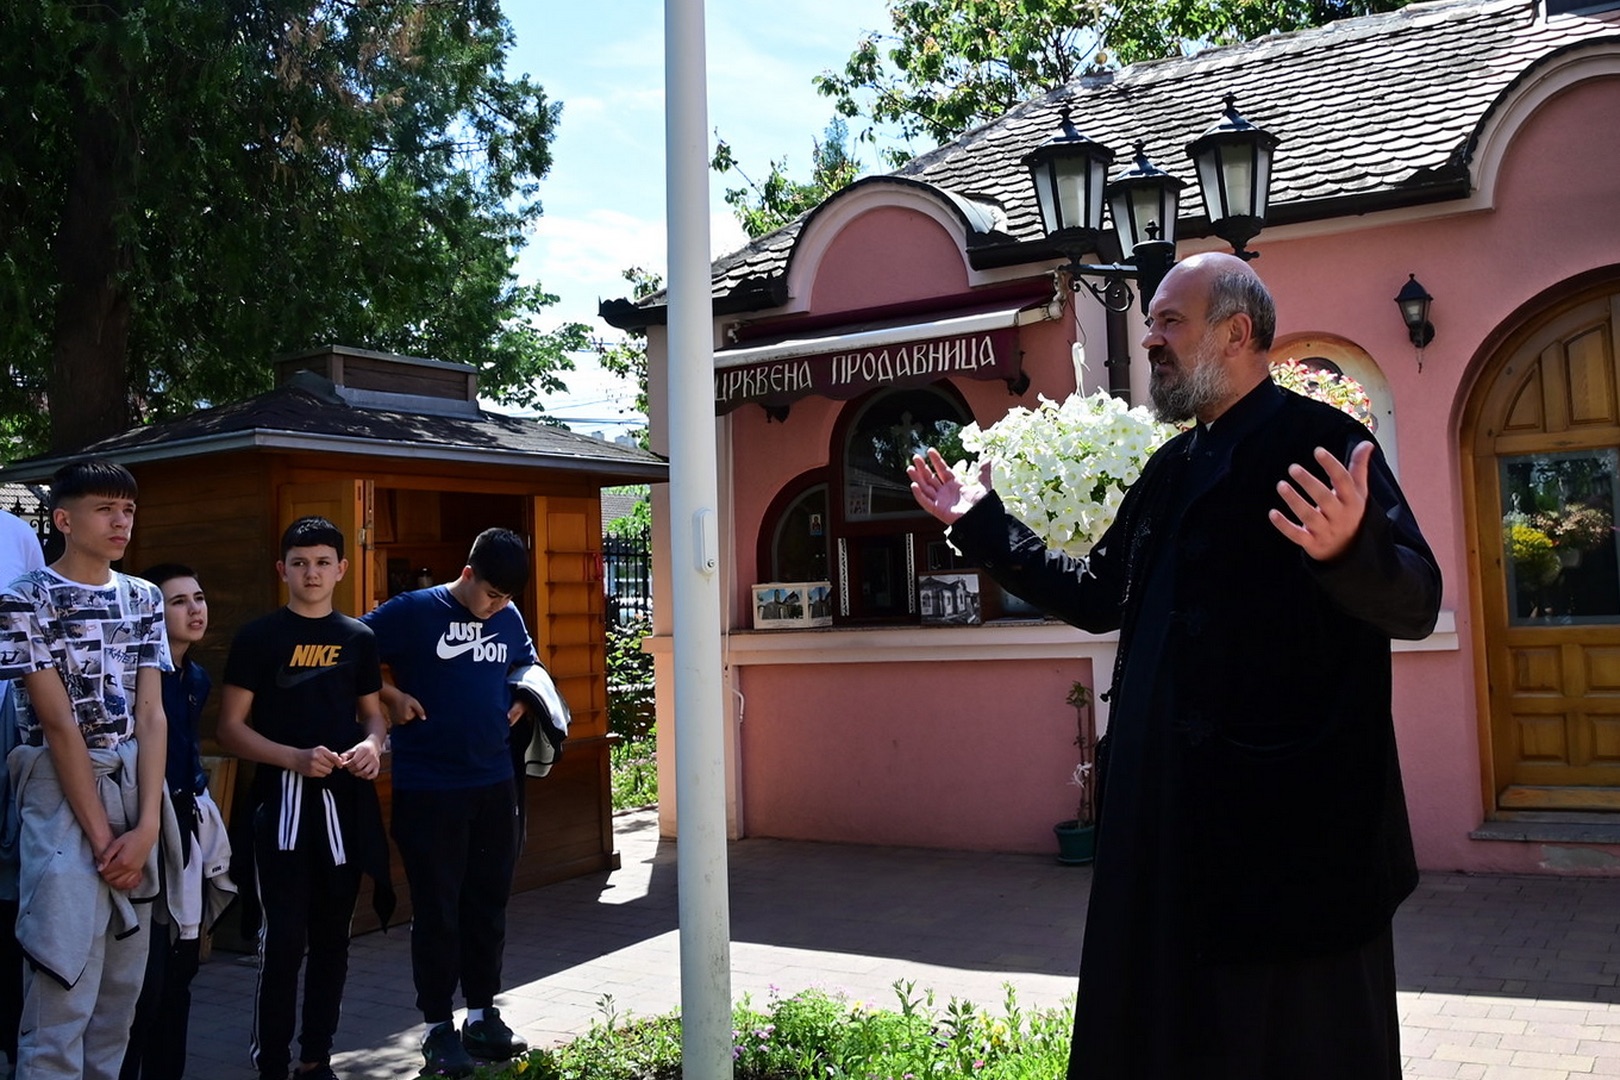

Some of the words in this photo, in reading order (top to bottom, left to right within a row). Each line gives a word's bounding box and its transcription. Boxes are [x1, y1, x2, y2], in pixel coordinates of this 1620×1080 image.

[831, 335, 996, 385] ПРОДАВНИЦА
[446, 621, 483, 641] JUST
[289, 644, 342, 667] NIKE
